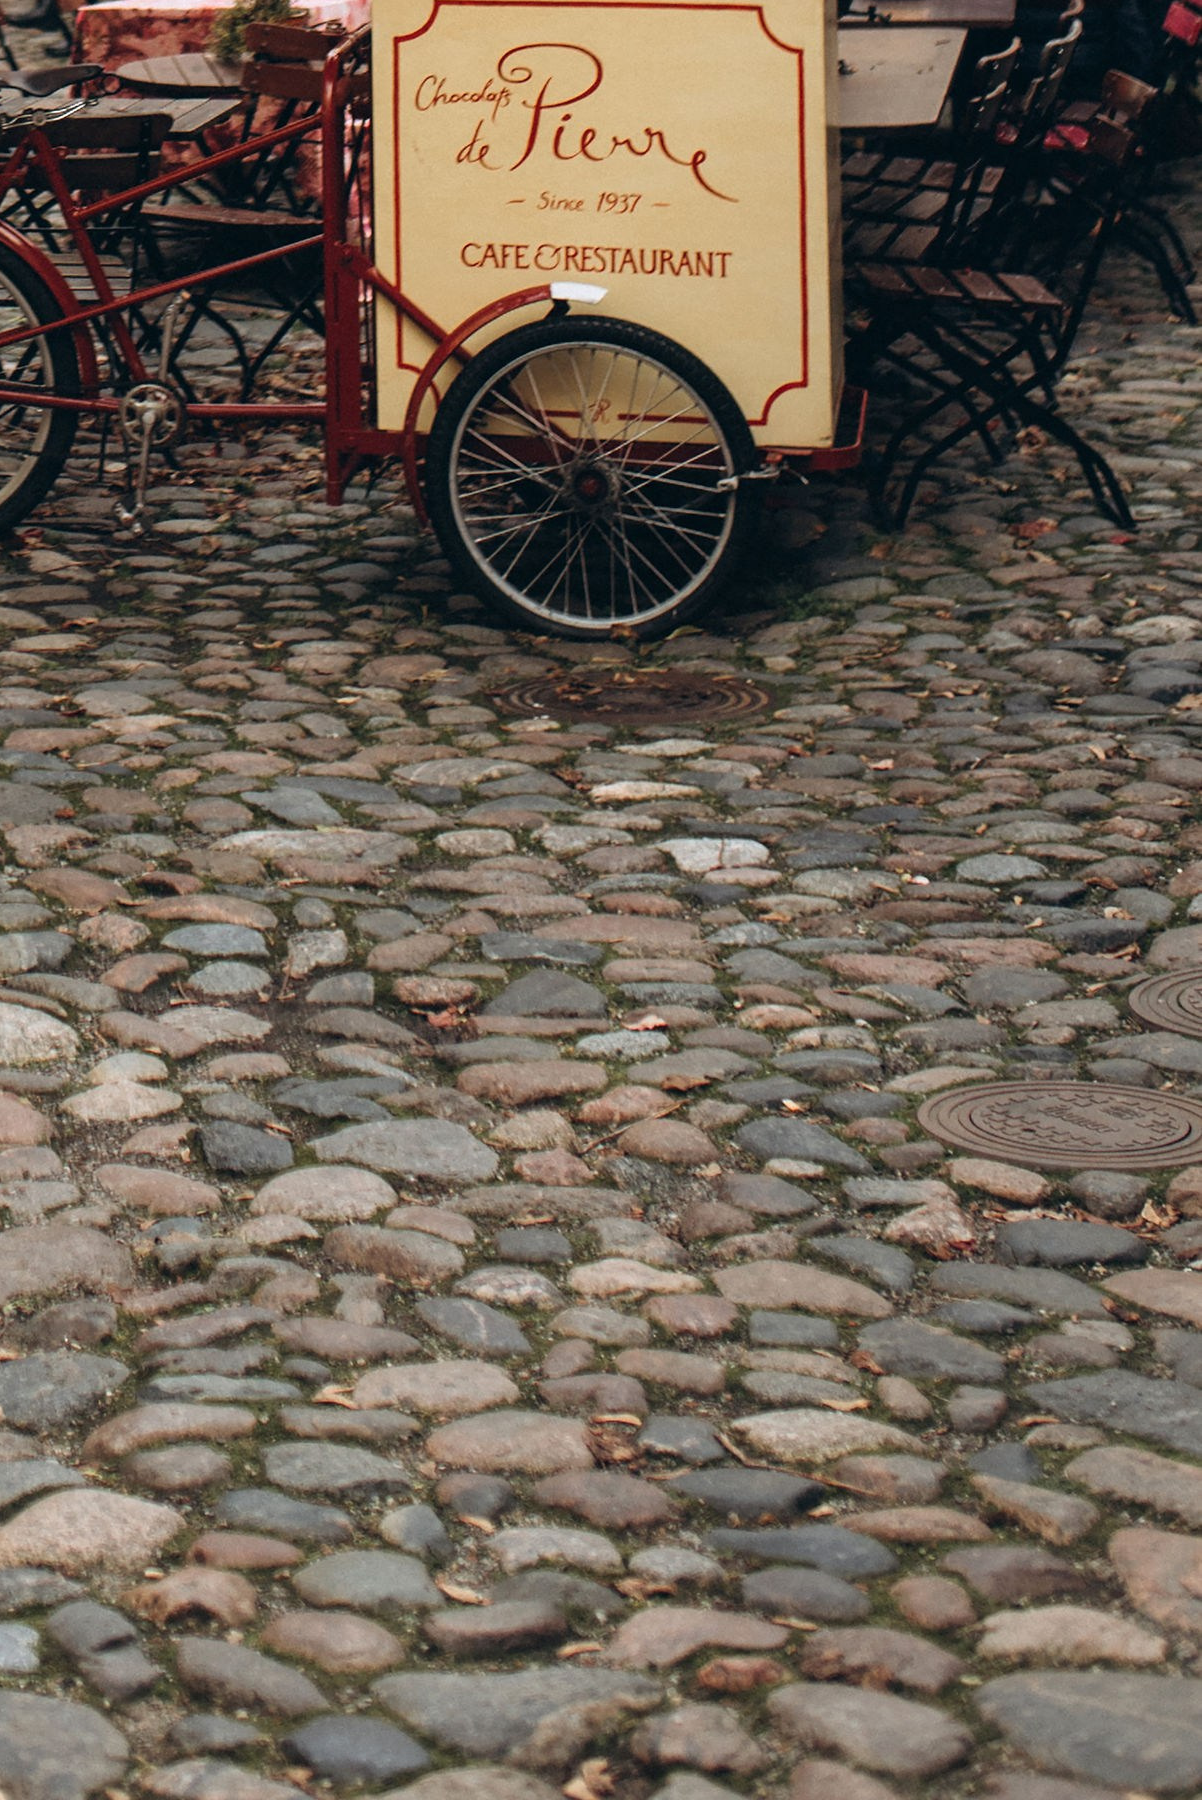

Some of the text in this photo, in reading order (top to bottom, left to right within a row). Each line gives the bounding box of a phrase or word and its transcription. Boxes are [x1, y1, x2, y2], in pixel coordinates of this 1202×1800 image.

[456, 43, 739, 203] de Pierre
[537, 191, 642, 214] Since 1937
